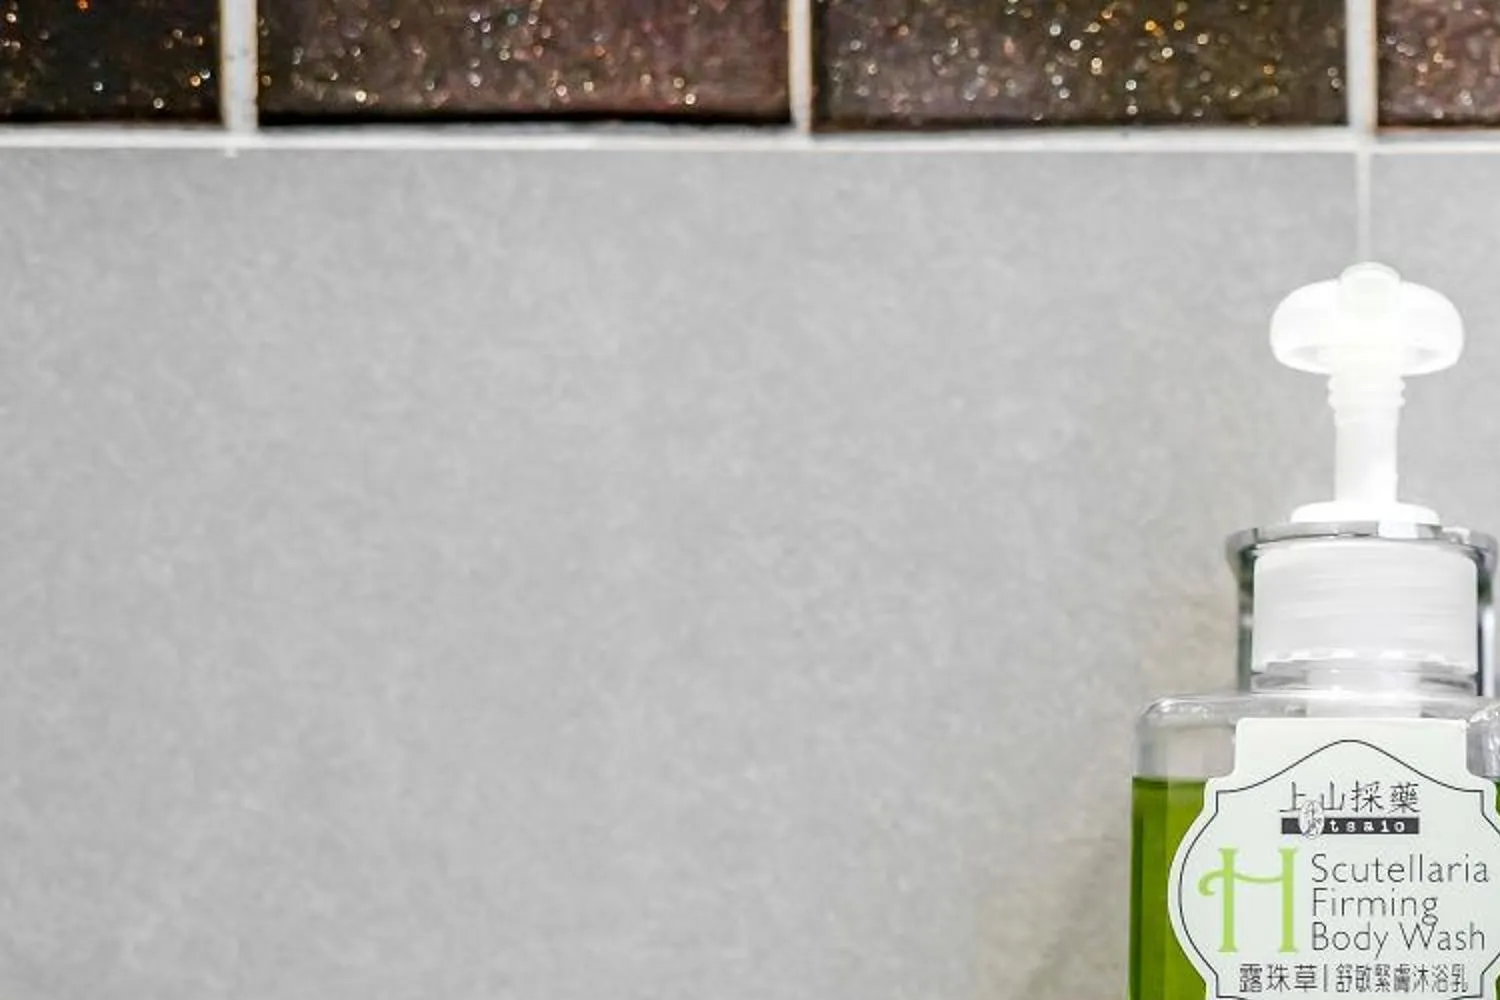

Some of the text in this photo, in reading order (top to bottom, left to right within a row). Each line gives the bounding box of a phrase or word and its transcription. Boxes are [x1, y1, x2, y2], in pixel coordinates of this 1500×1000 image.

[1280, 780, 1421, 813] 上山採藥
[1311, 853, 1488, 883] Scutellaria
[1312, 887, 1438, 926] Firming
[1312, 921, 1486, 960] Body Wash
